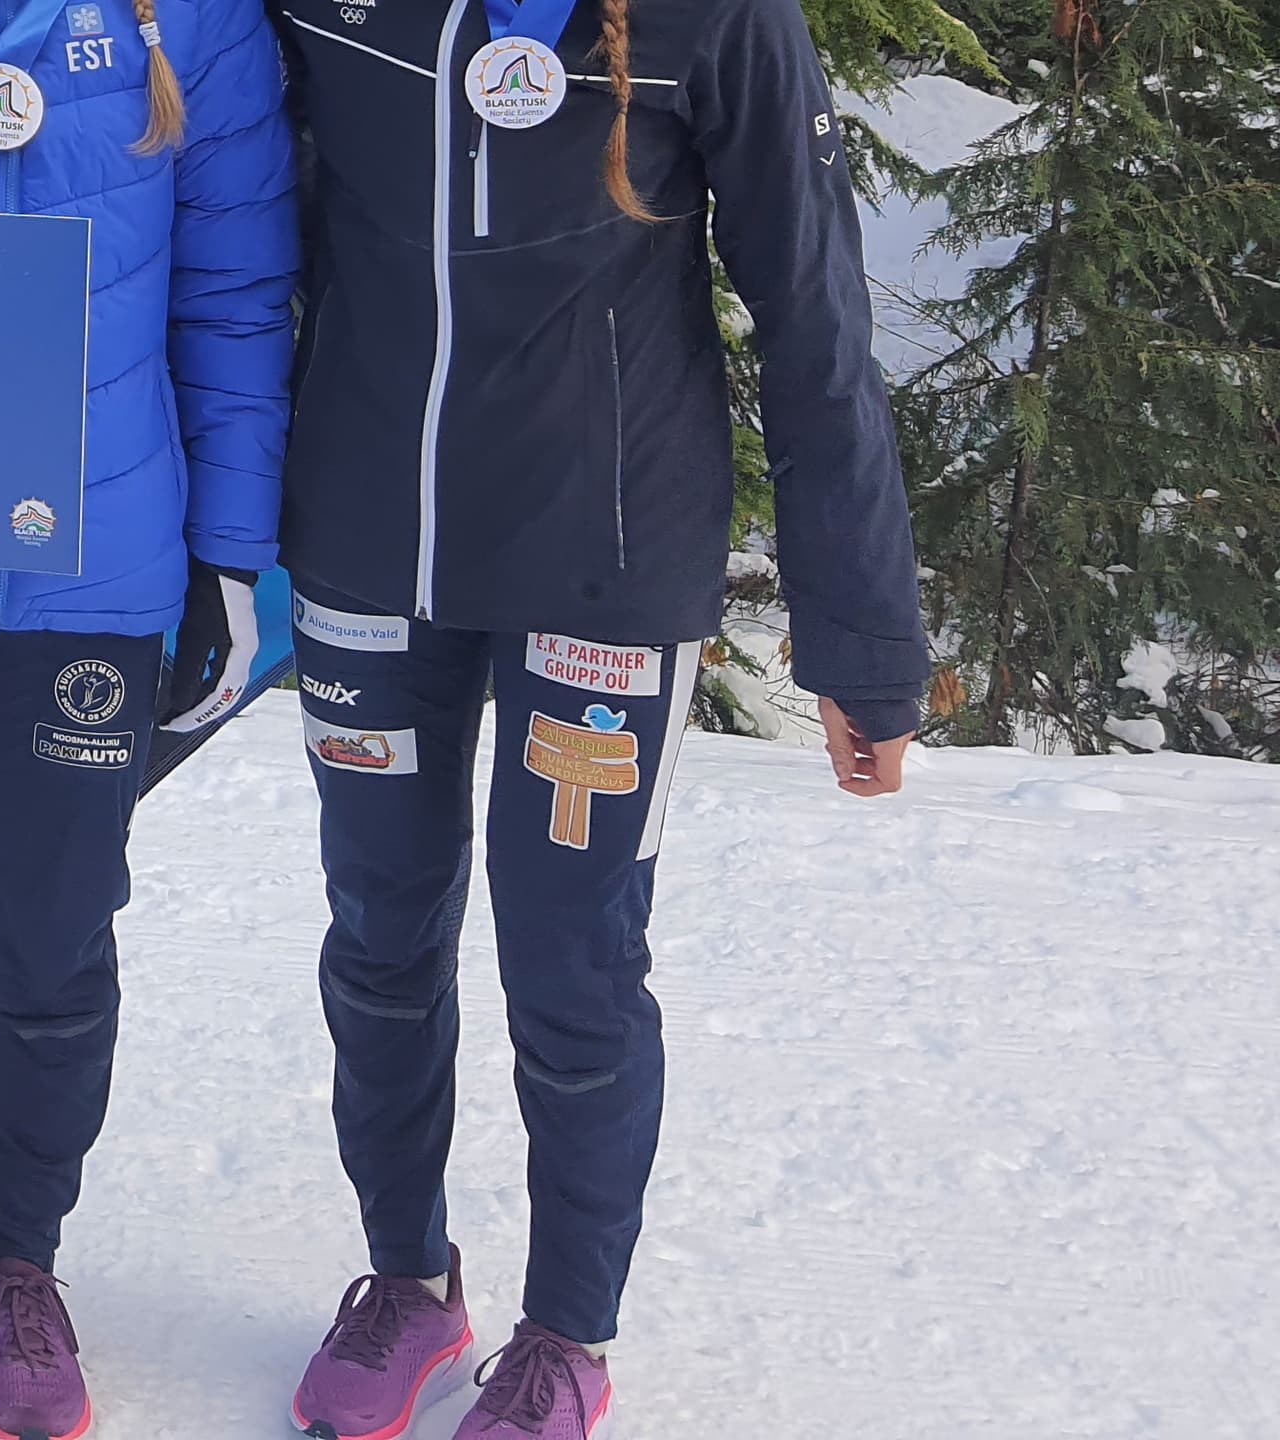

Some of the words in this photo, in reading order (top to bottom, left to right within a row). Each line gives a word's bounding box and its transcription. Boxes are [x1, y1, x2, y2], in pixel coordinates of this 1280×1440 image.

[65, 37, 114, 73] EST
[485, 98, 518, 108] BLACK
[519, 97, 547, 106] TUSK
[0, 121, 24, 131] TUSK
[308, 615, 367, 639] Alutaguse
[371, 628, 399, 639] Vald
[536, 633, 562, 657] E.K.
[567, 643, 645, 670] PARTNER
[59, 663, 118, 691] SUUSASEMUD
[545, 658, 600, 686] GRUPP
[605, 670, 630, 690] OÜ
[60, 697, 86, 720] DOUBLE
[540, 726, 625, 756] Alutaguse
[534, 760, 625, 788] SPORDIKESKUS
